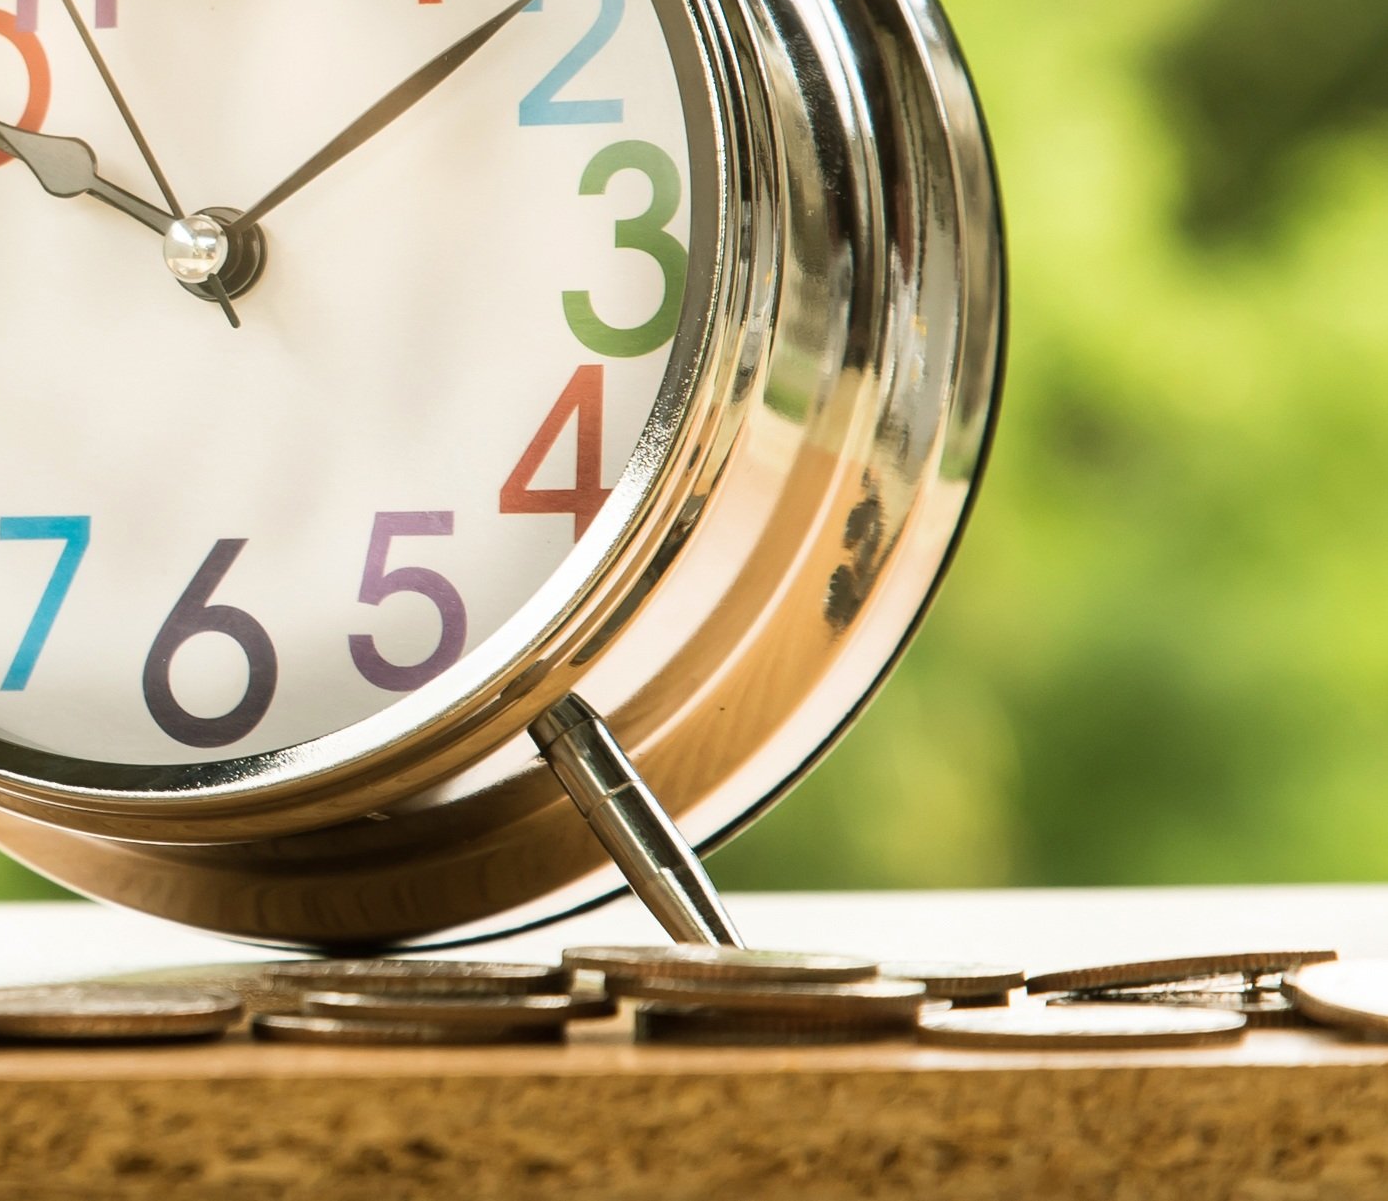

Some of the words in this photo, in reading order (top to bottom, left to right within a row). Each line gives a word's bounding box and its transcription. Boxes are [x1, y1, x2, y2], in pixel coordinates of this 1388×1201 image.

[562, 139, 686, 358] 3
[499, 364, 612, 543] 4
[143, 538, 277, 748] 6
[348, 511, 467, 692] 5
